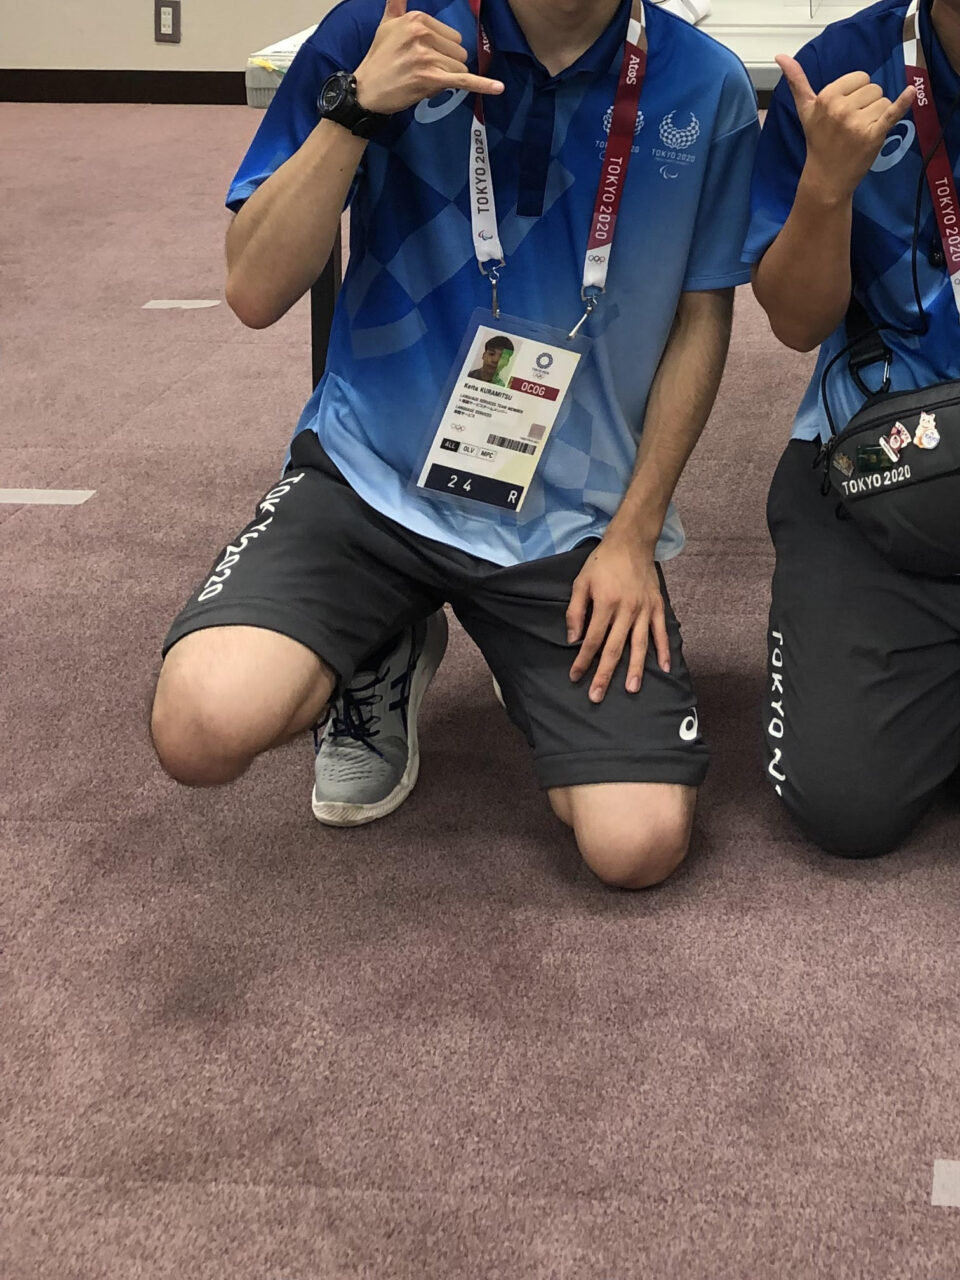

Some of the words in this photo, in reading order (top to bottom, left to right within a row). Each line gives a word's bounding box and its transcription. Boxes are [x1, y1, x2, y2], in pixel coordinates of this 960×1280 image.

[626, 54, 640, 85] Atos
[913, 76, 928, 107] Atos
[474, 129, 486, 164] 2020
[651, 148, 677, 159] TOKYO
[677, 152, 697, 163] 2020
[474, 167, 490, 215] TOKYO
[602, 157, 623, 202] TOKYO
[935, 177, 957, 225] TOKYO
[595, 205, 613, 240] 2020
[521, 382, 546, 396] OCOG
[842, 474, 881, 495] TOKYO
[883, 464, 911, 485] 2020
[507, 490, 518, 504] R
[768, 630, 784, 739] TOKYO
